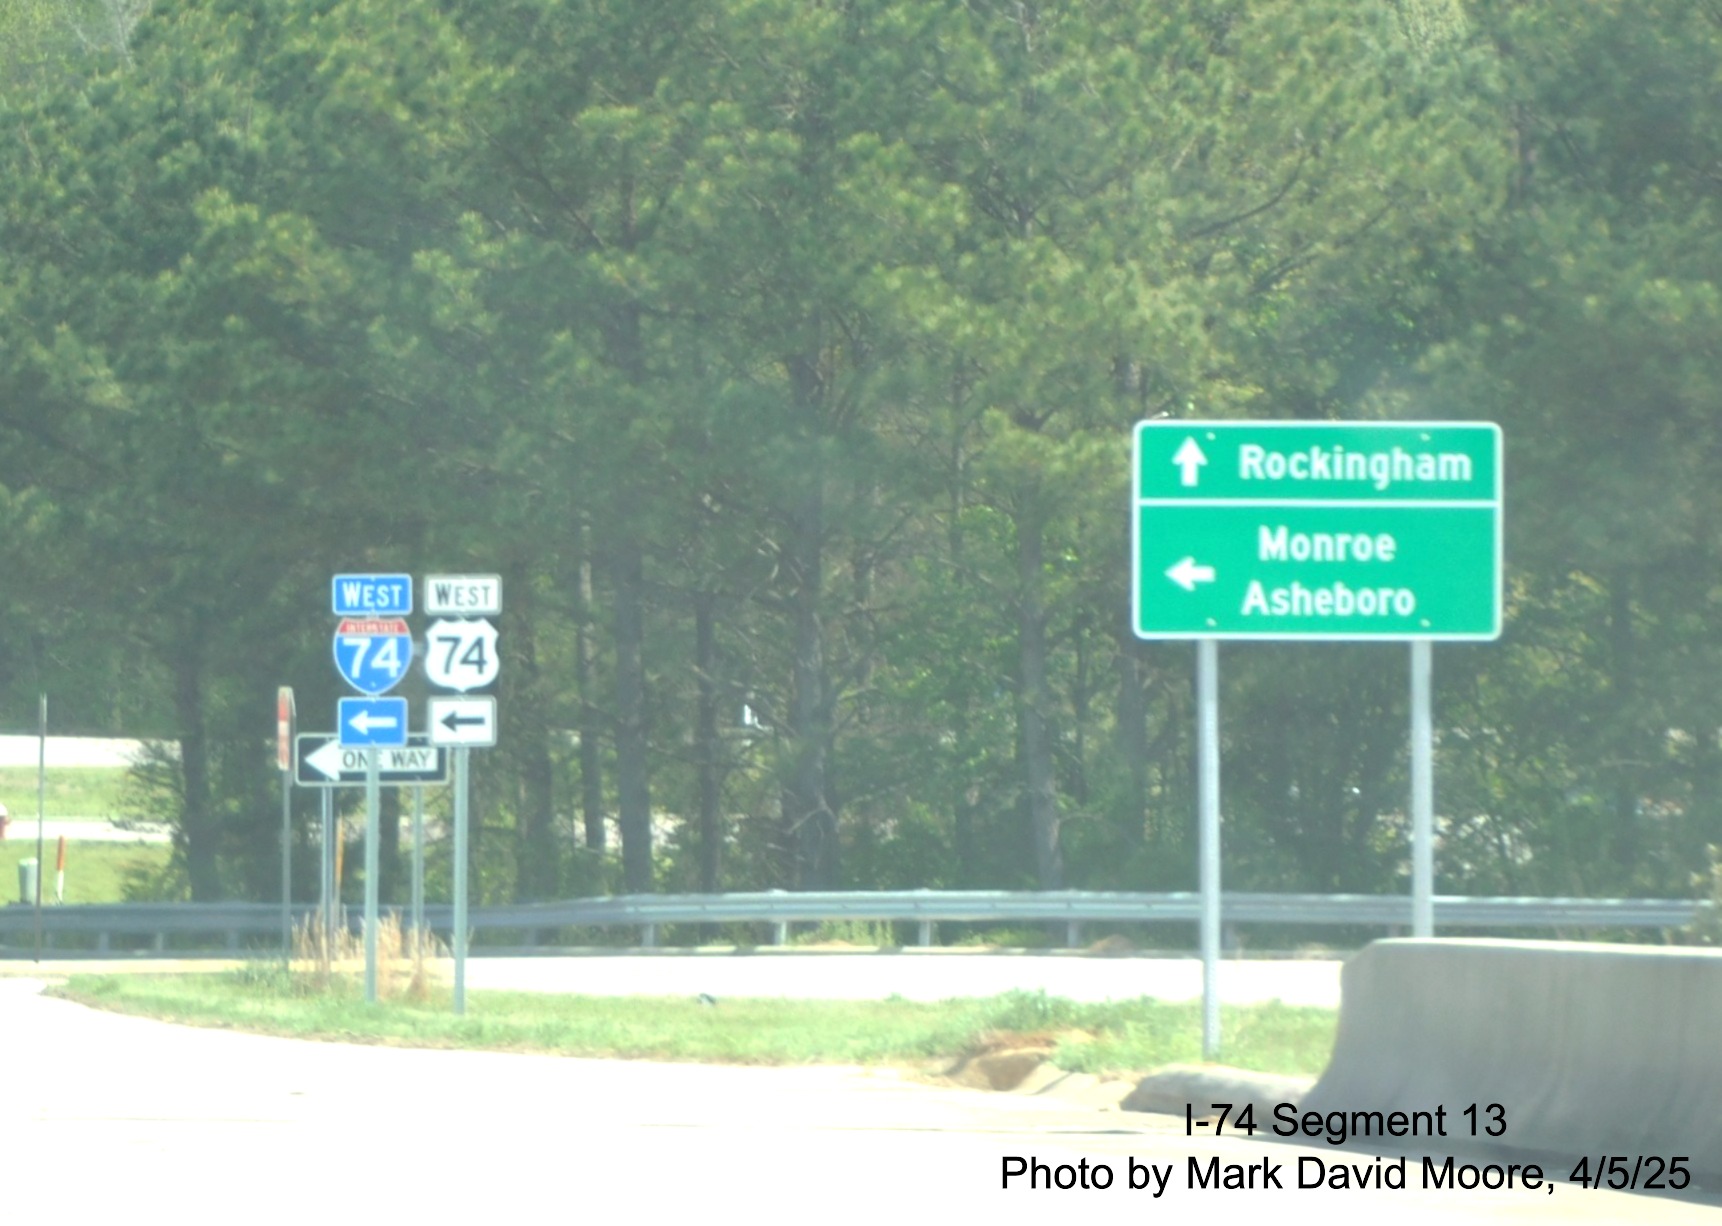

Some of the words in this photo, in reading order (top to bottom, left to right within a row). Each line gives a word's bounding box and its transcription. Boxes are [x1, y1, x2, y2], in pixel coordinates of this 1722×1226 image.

[1238, 444, 1472, 491] Rockingham
[1258, 525, 1397, 561] Monroe
[342, 581, 402, 608] WEST
[435, 582, 491, 606] WEST
[1240, 580, 1416, 616] Asheboro
[343, 637, 401, 678] 74
[436, 636, 487, 675] 74
[391, 751, 431, 768] WAY
